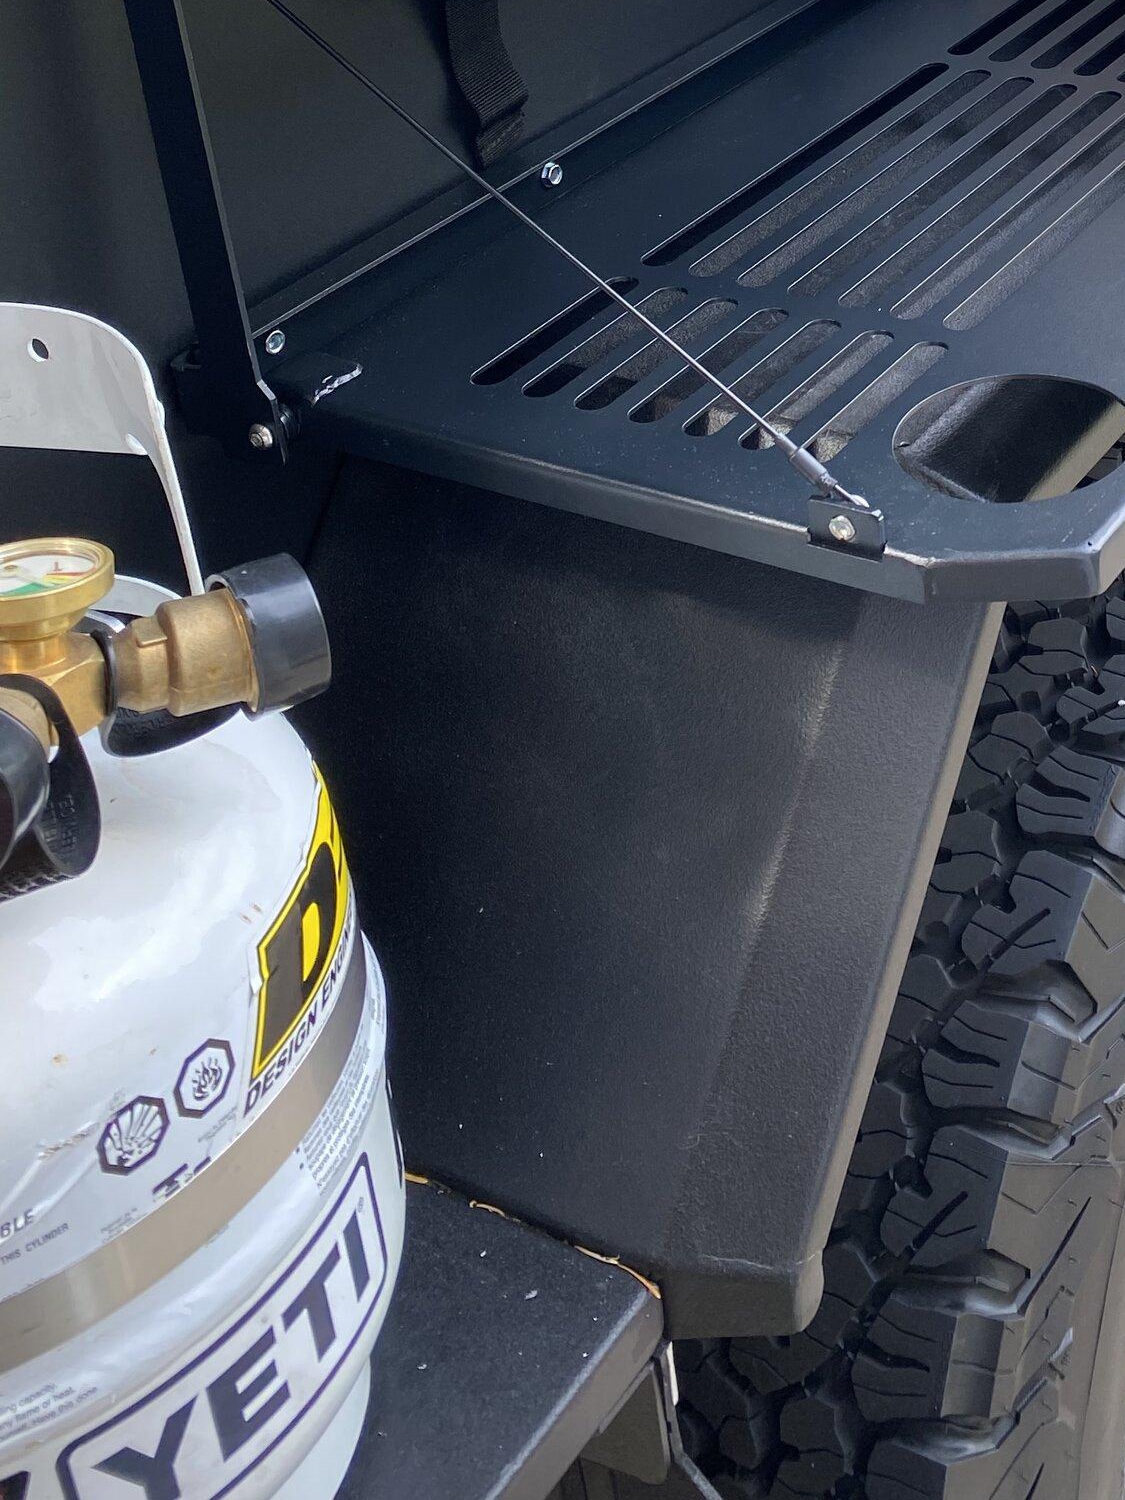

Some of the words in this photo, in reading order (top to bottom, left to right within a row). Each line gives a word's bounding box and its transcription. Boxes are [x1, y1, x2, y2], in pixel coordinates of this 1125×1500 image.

[243, 1002, 318, 1118] DESIGN
[0, 1248, 21, 1265] THIS
[25, 1222, 69, 1252] CYLINDER
[91, 1209, 371, 1500] YETI
